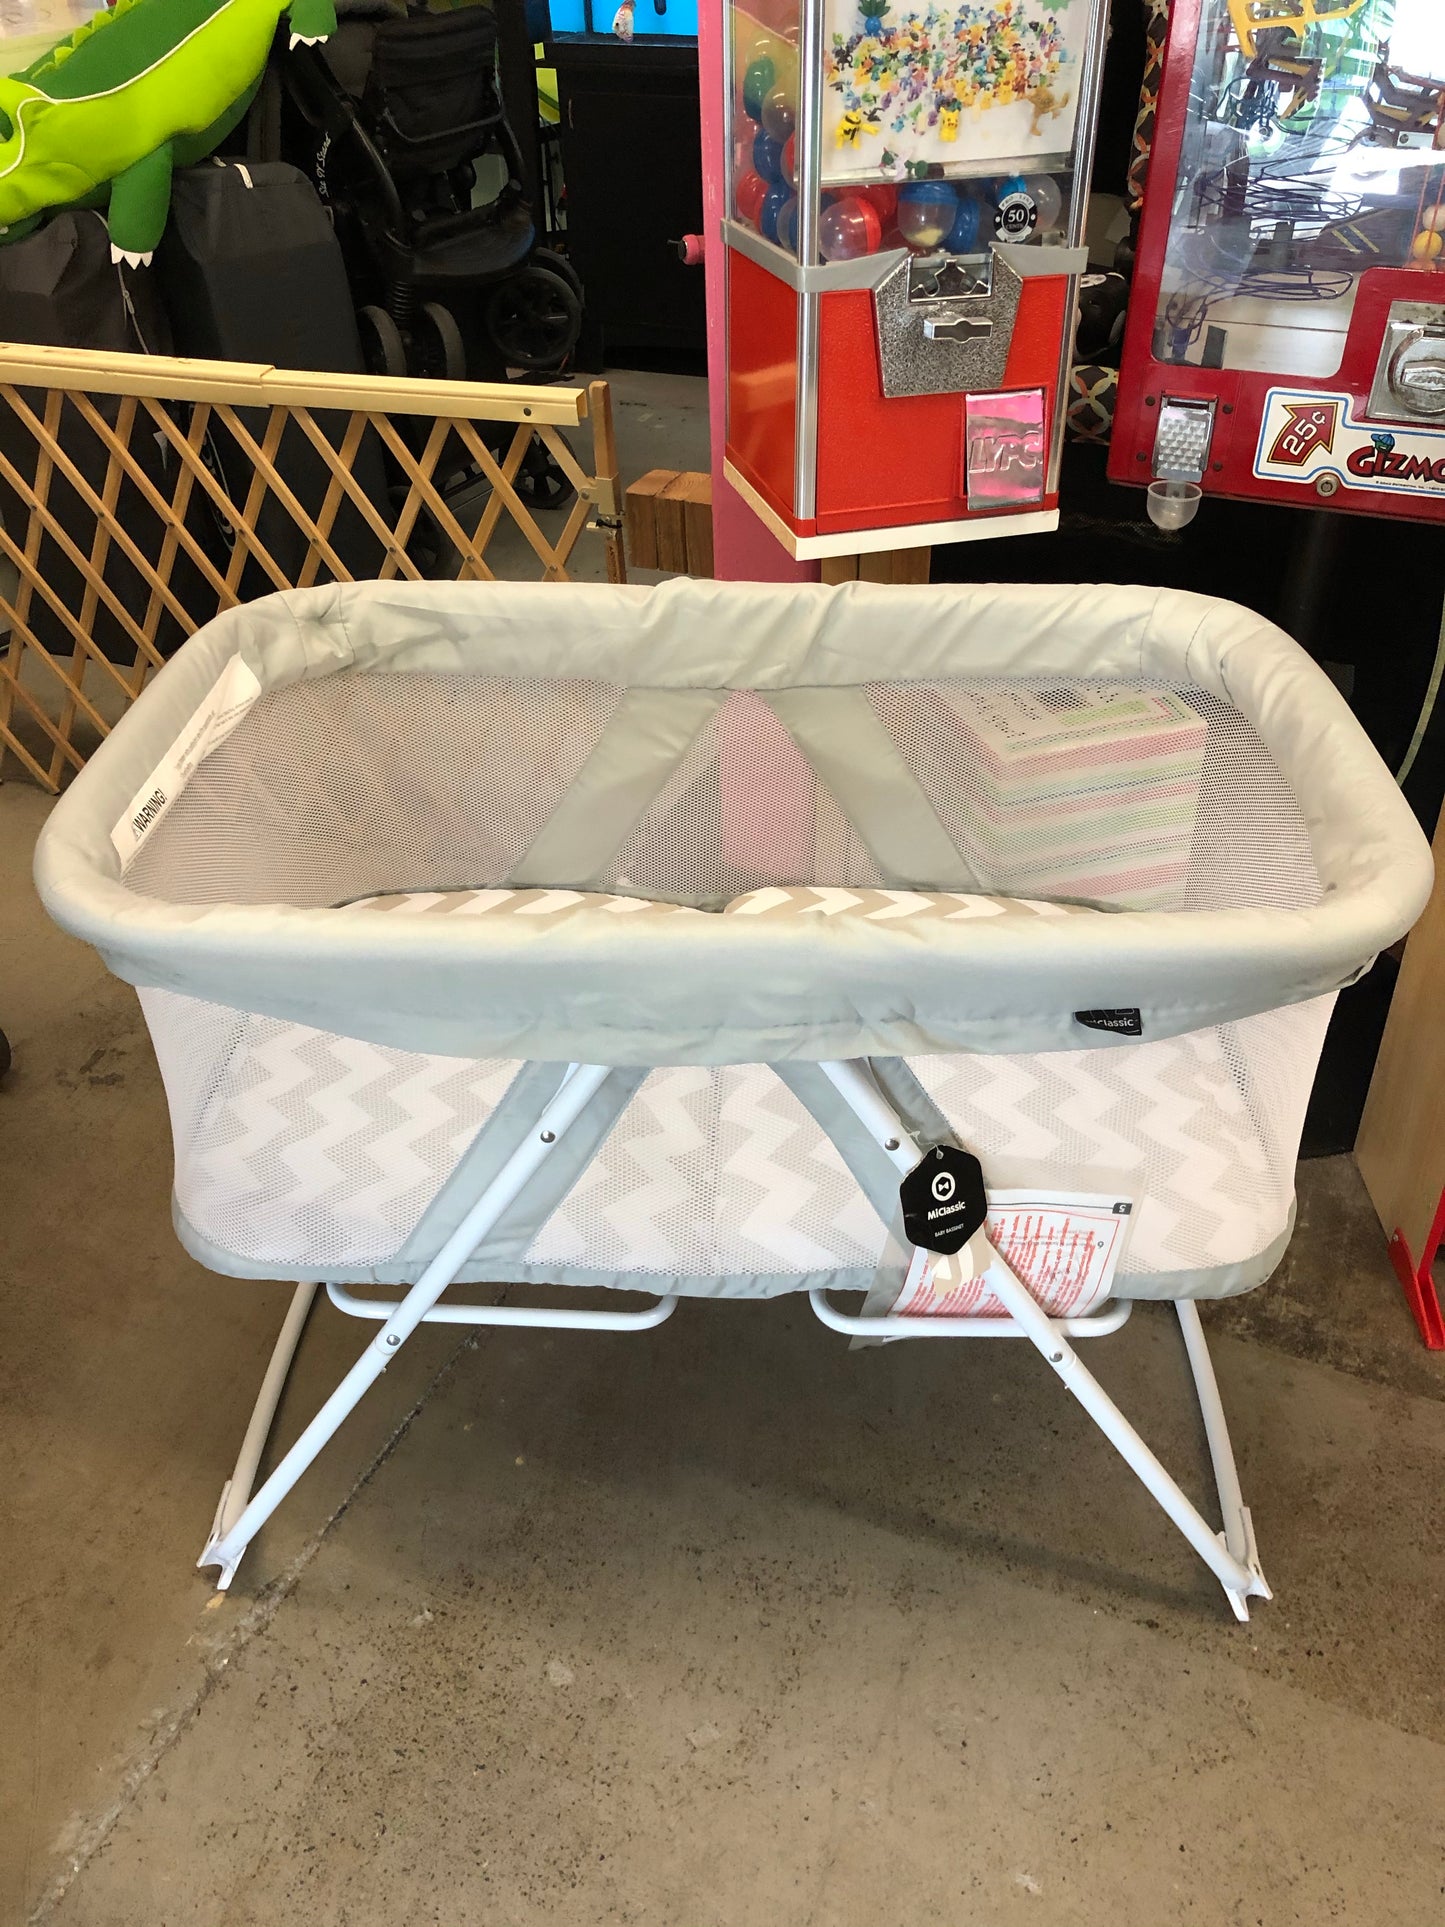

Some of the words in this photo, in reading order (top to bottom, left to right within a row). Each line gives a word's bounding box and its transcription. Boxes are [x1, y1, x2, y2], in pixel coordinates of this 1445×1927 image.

[1007, 209, 1025, 222] 50
[132, 788, 167, 833] WARNING!
[927, 1201, 966, 1221] MiClassic
